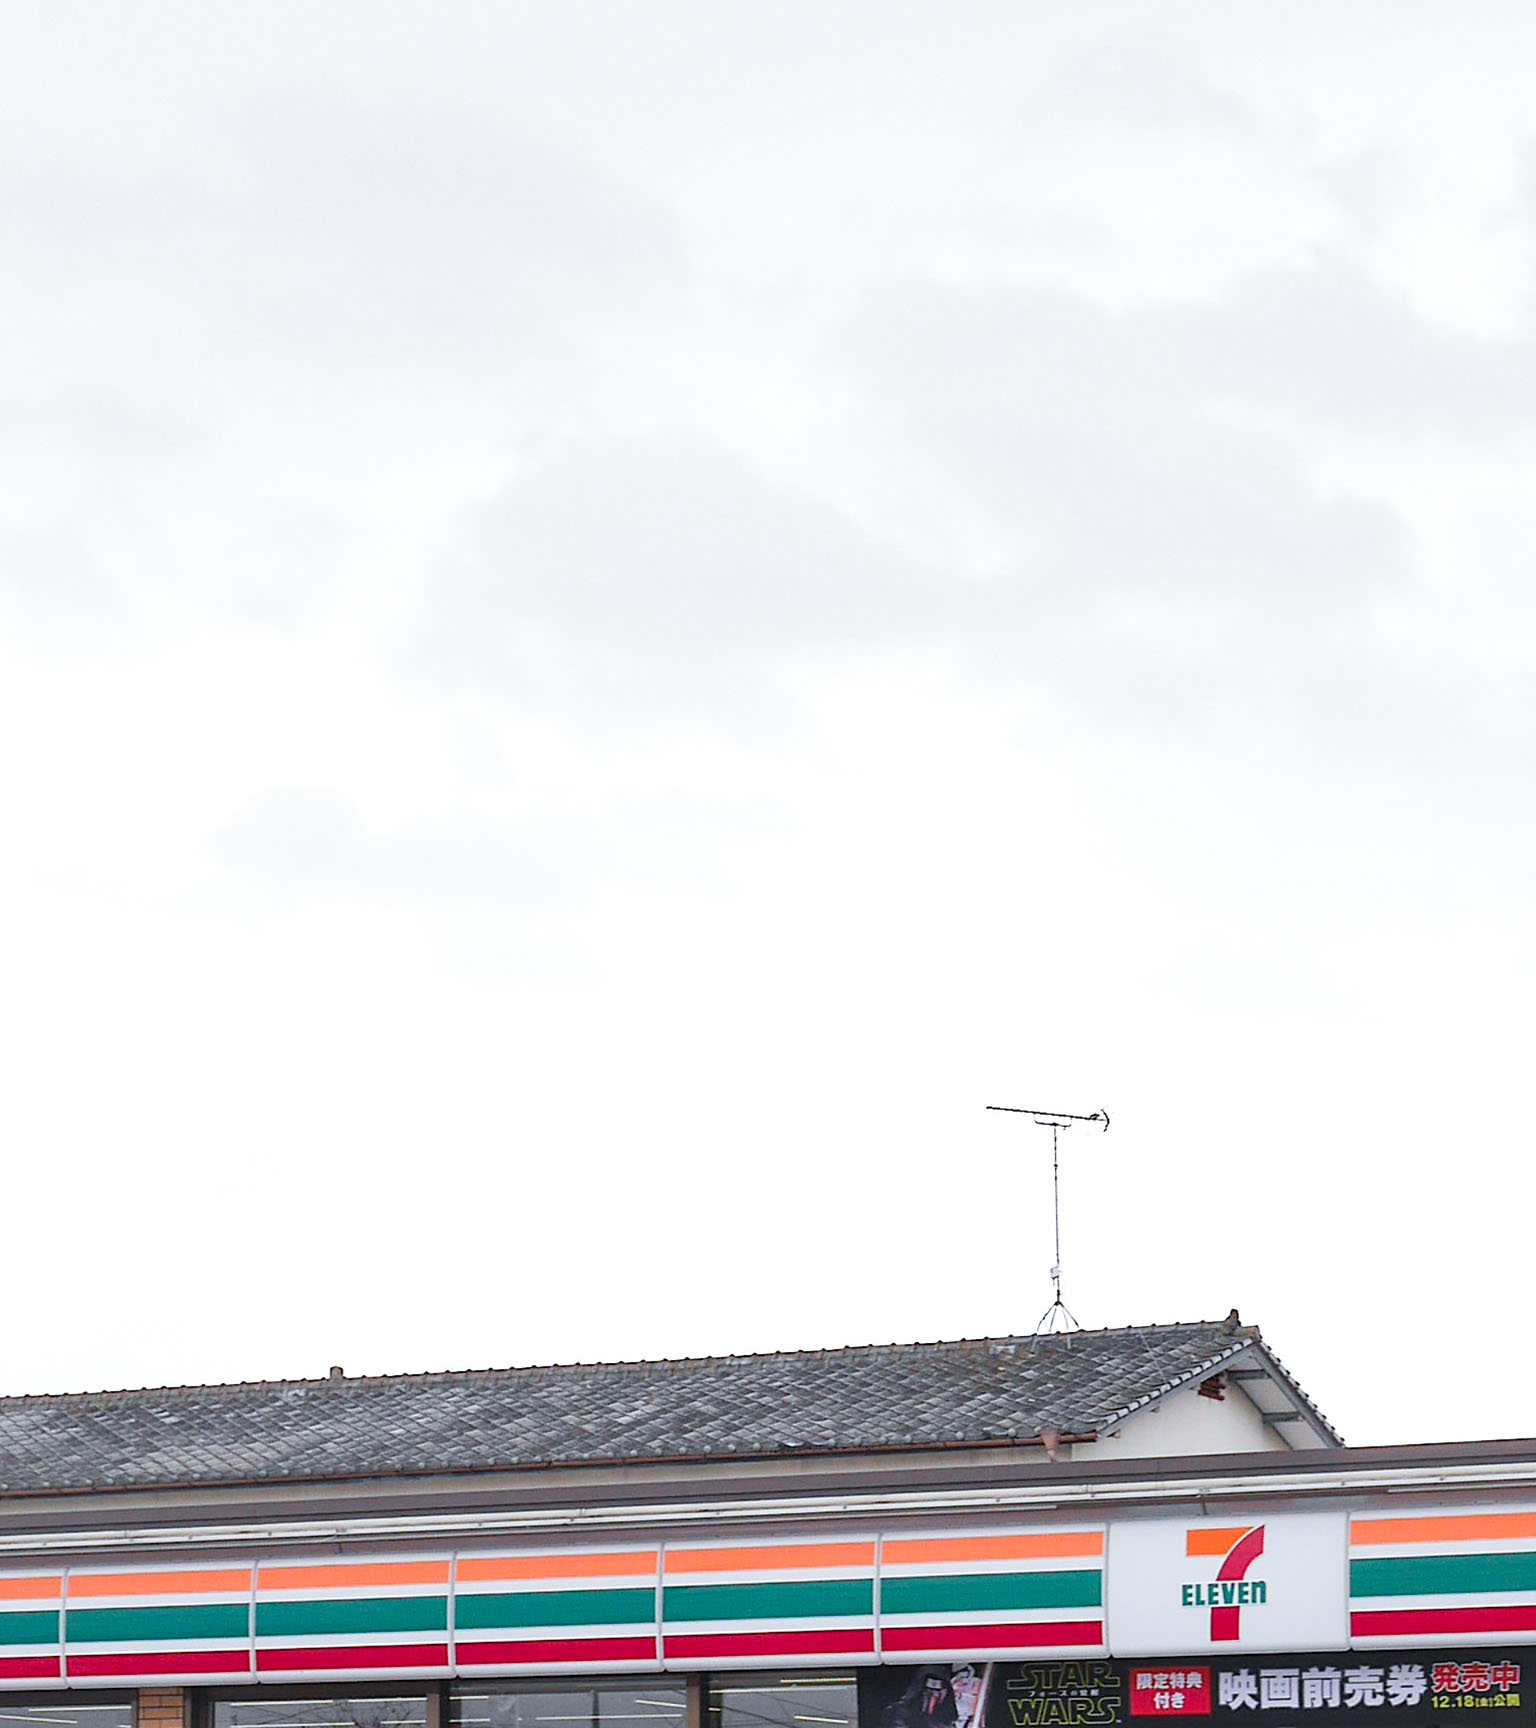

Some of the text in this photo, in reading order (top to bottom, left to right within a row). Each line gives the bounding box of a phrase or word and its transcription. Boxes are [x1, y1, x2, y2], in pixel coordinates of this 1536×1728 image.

[1186, 1524, 1265, 1641] 7
[1007, 1661, 1120, 1690] STAR
[1136, 1672, 1202, 1690] 限定特典
[1218, 1664, 1427, 1710] 映画前売券
[1432, 1661, 1520, 1692] 発売中
[1007, 1697, 1121, 1725] WARS
[1153, 1692, 1186, 1709] 付き
